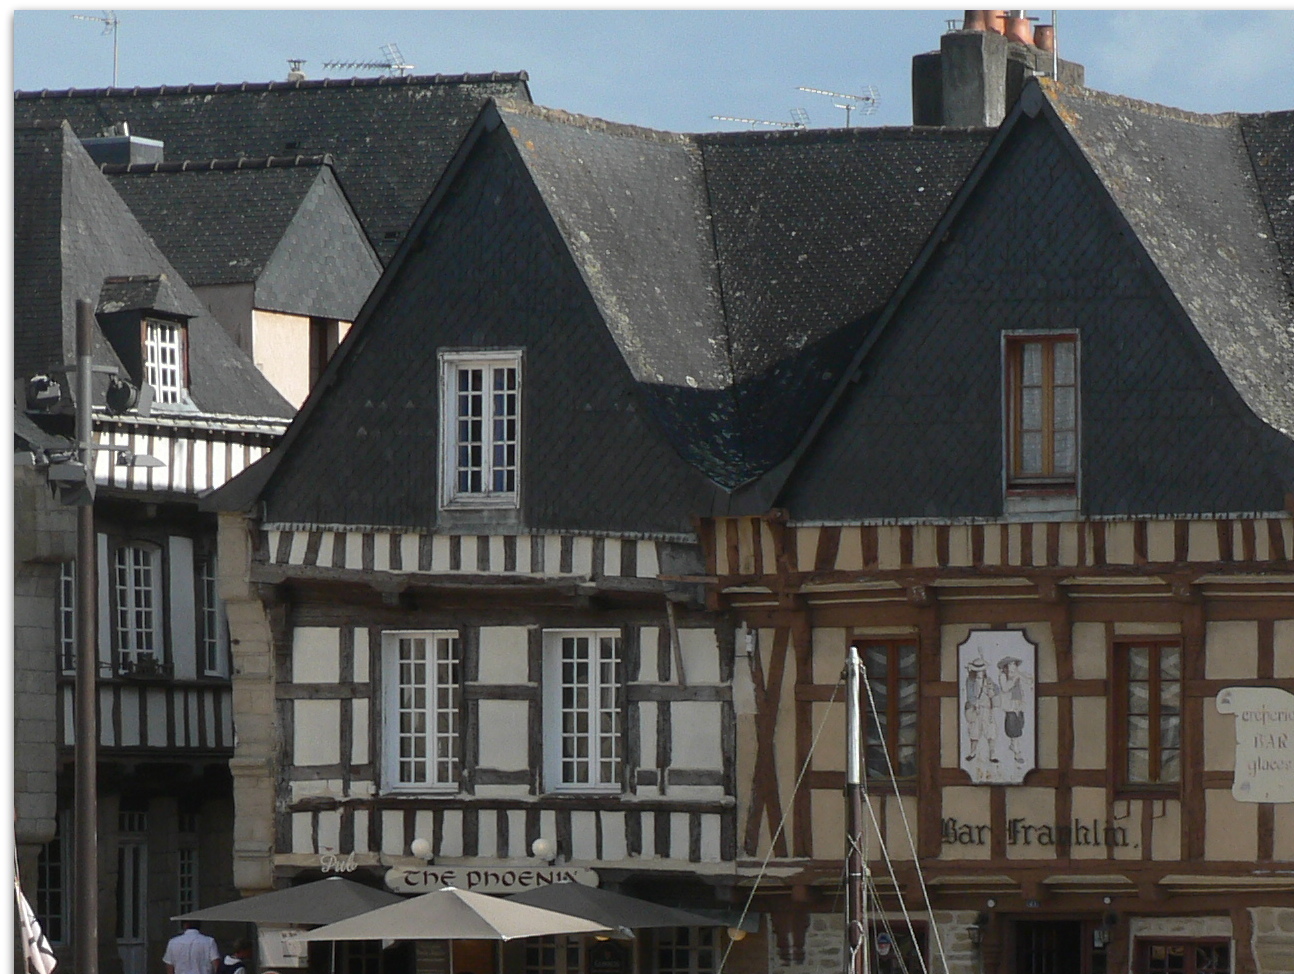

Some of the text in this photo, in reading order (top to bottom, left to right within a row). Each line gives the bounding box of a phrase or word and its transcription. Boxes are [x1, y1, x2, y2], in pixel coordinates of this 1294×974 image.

[1254, 733, 1288, 749] BAR
[1247, 757, 1292, 777] glaces
[941, 817, 991, 846] Bar
[320, 851, 358, 873] Pub
